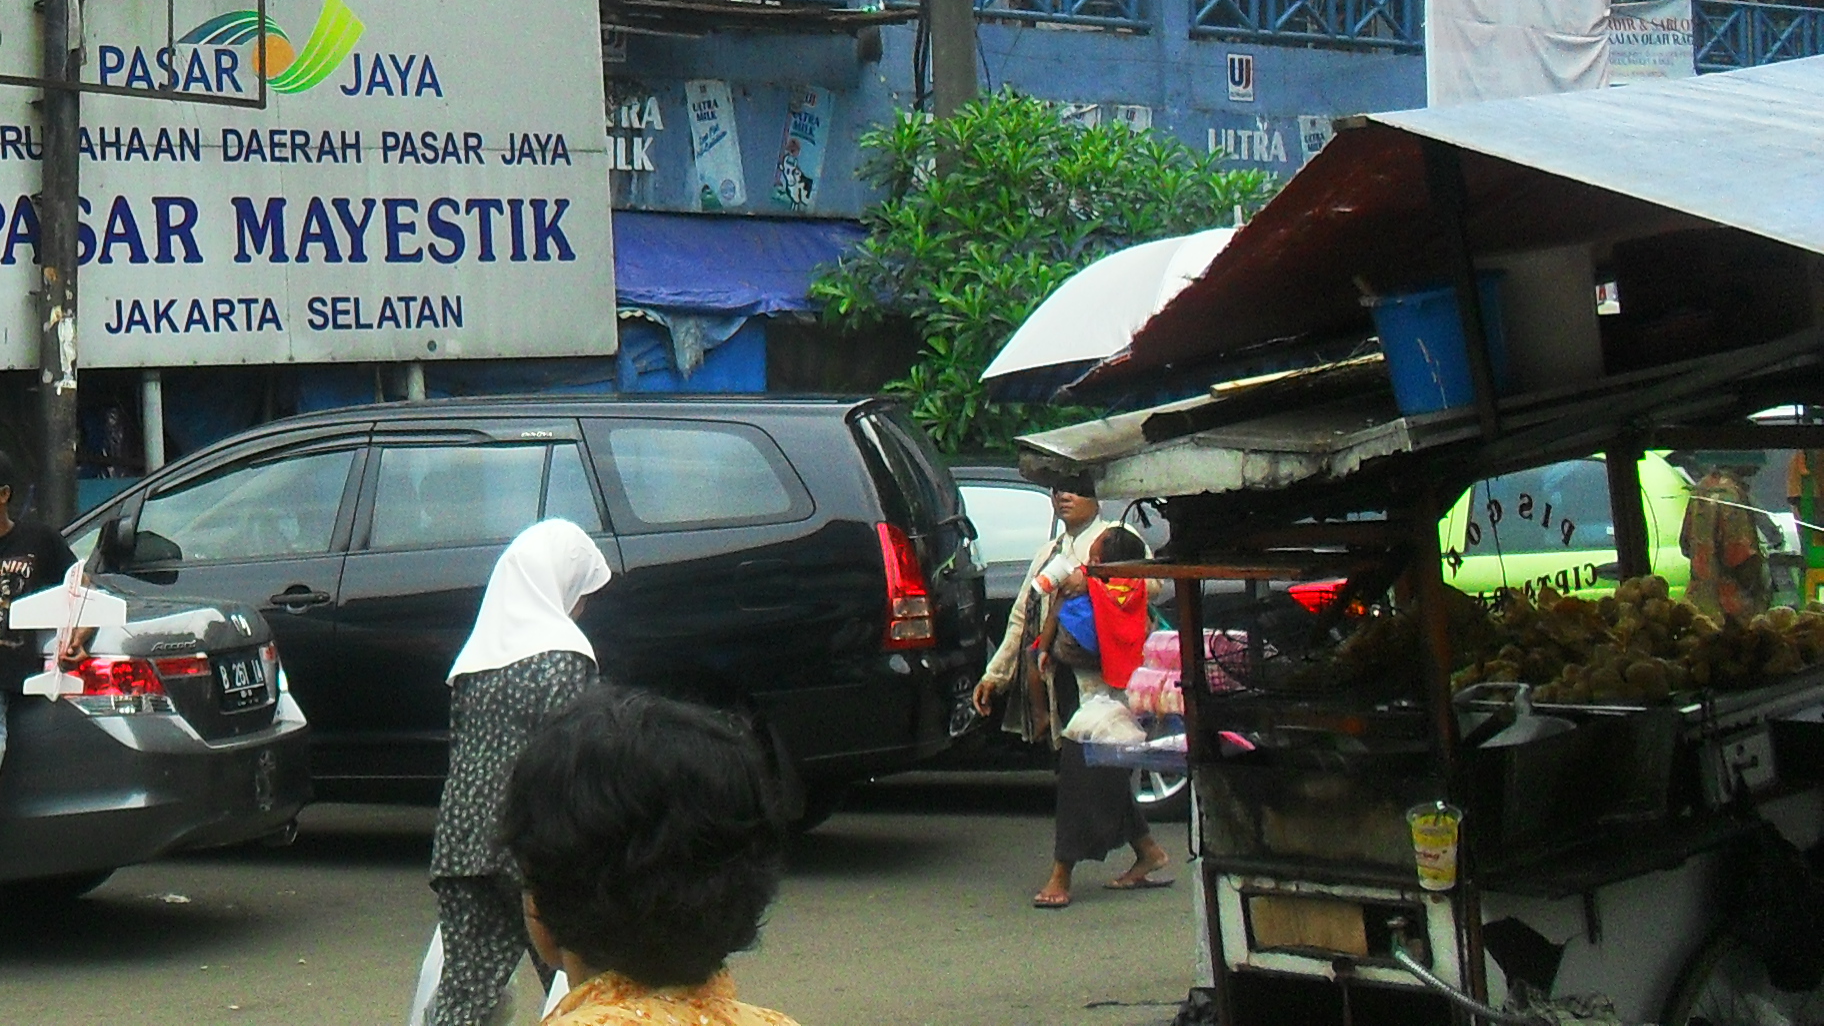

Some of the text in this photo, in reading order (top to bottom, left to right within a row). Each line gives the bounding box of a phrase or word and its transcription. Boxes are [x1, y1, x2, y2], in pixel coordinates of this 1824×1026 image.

[99, 43, 444, 99] PASAR JAYA
[222, 128, 362, 166] DAERAH
[382, 131, 484, 166] PASAR
[501, 132, 572, 167] JAYA
[232, 196, 577, 265] MAYESTIK
[104, 294, 465, 336] JAKARTA SELATAN
[151, 639, 197, 652] Accord
[219, 664, 231, 690] B
